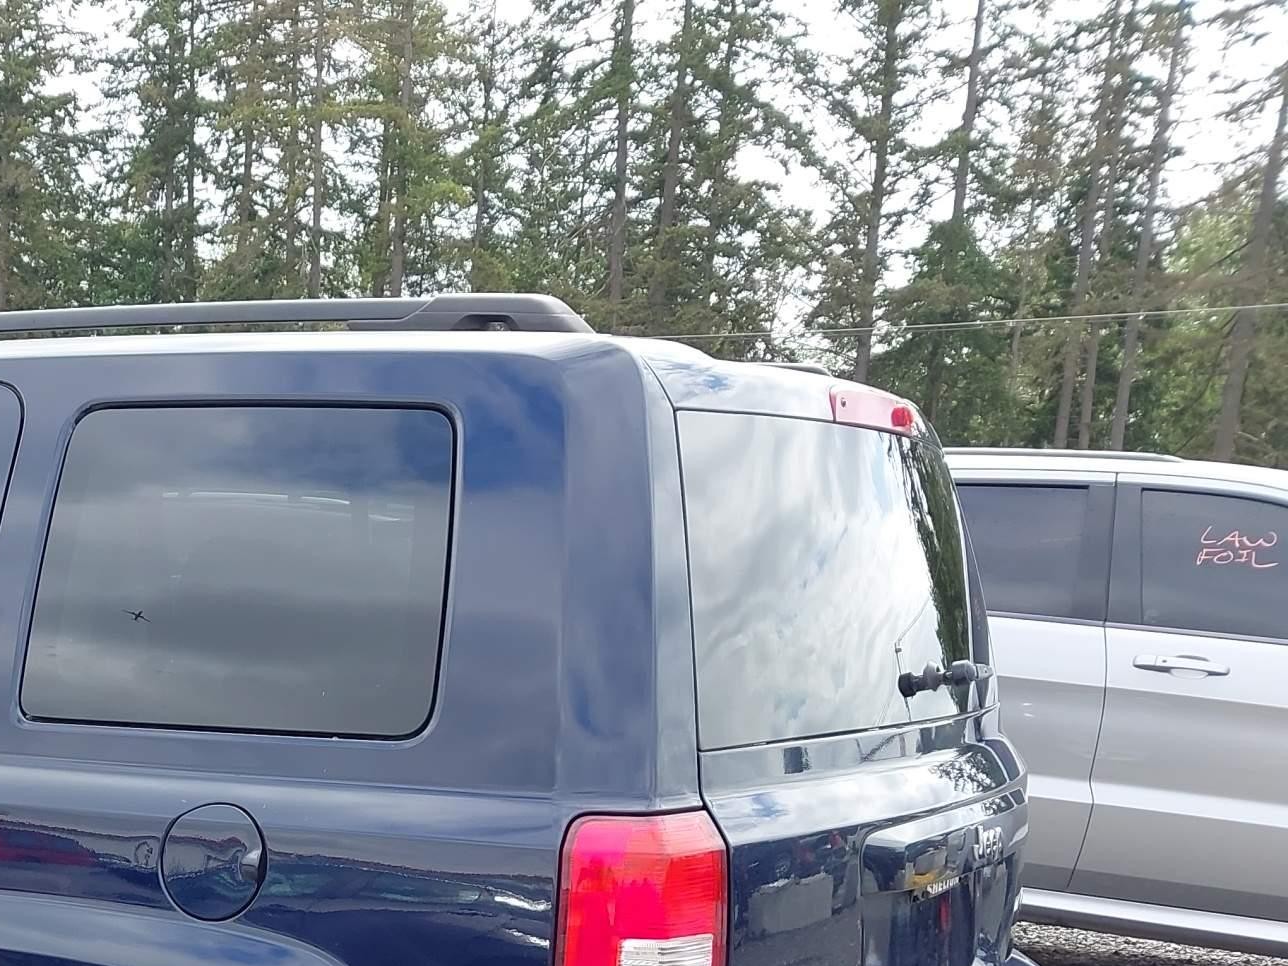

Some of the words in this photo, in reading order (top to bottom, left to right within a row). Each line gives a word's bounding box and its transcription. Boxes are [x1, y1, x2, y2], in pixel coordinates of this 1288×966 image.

[1200, 525, 1277, 547] LAW
[1196, 548, 1279, 568] FOIL
[972, 825, 1003, 861] Jeep
